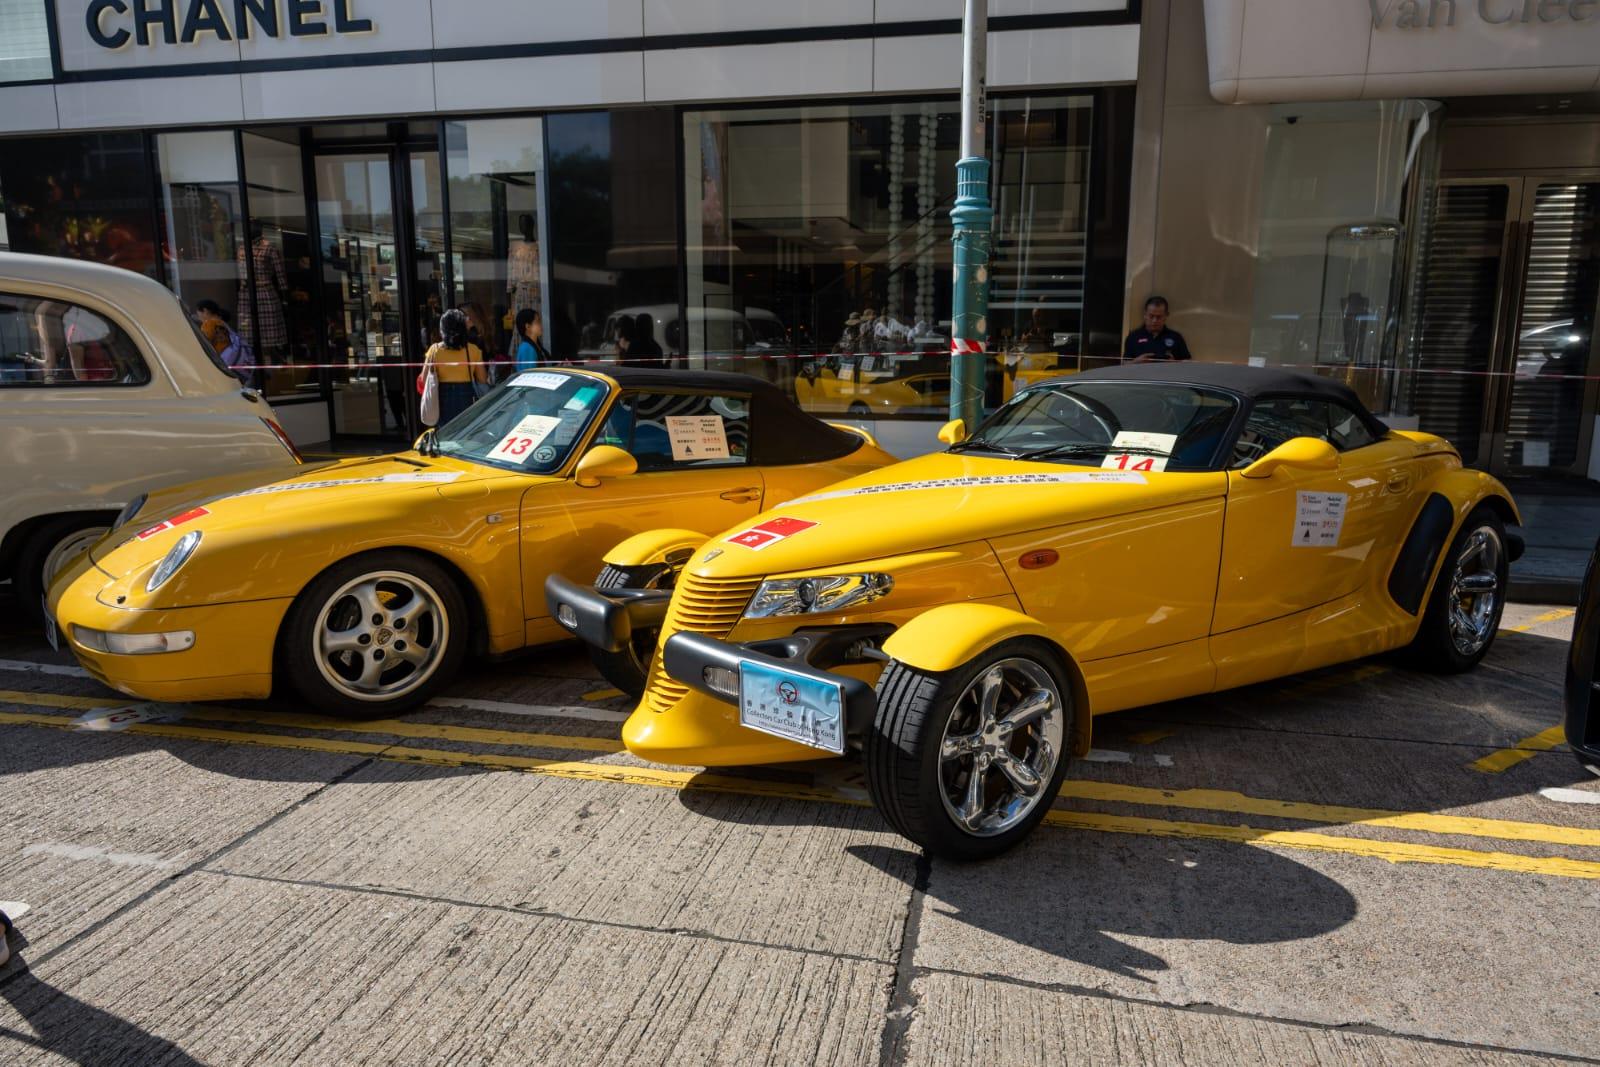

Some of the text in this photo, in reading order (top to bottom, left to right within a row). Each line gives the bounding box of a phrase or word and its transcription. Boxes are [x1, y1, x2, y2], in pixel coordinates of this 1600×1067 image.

[86, 0, 375, 49] CHANEL
[1370, 0, 1457, 29] Van
[501, 436, 533, 455] 13
[1114, 453, 1155, 472] 14
[773, 716, 782, 724] Car
[783, 718, 797, 728] Club
[820, 729, 836, 741] Kong
